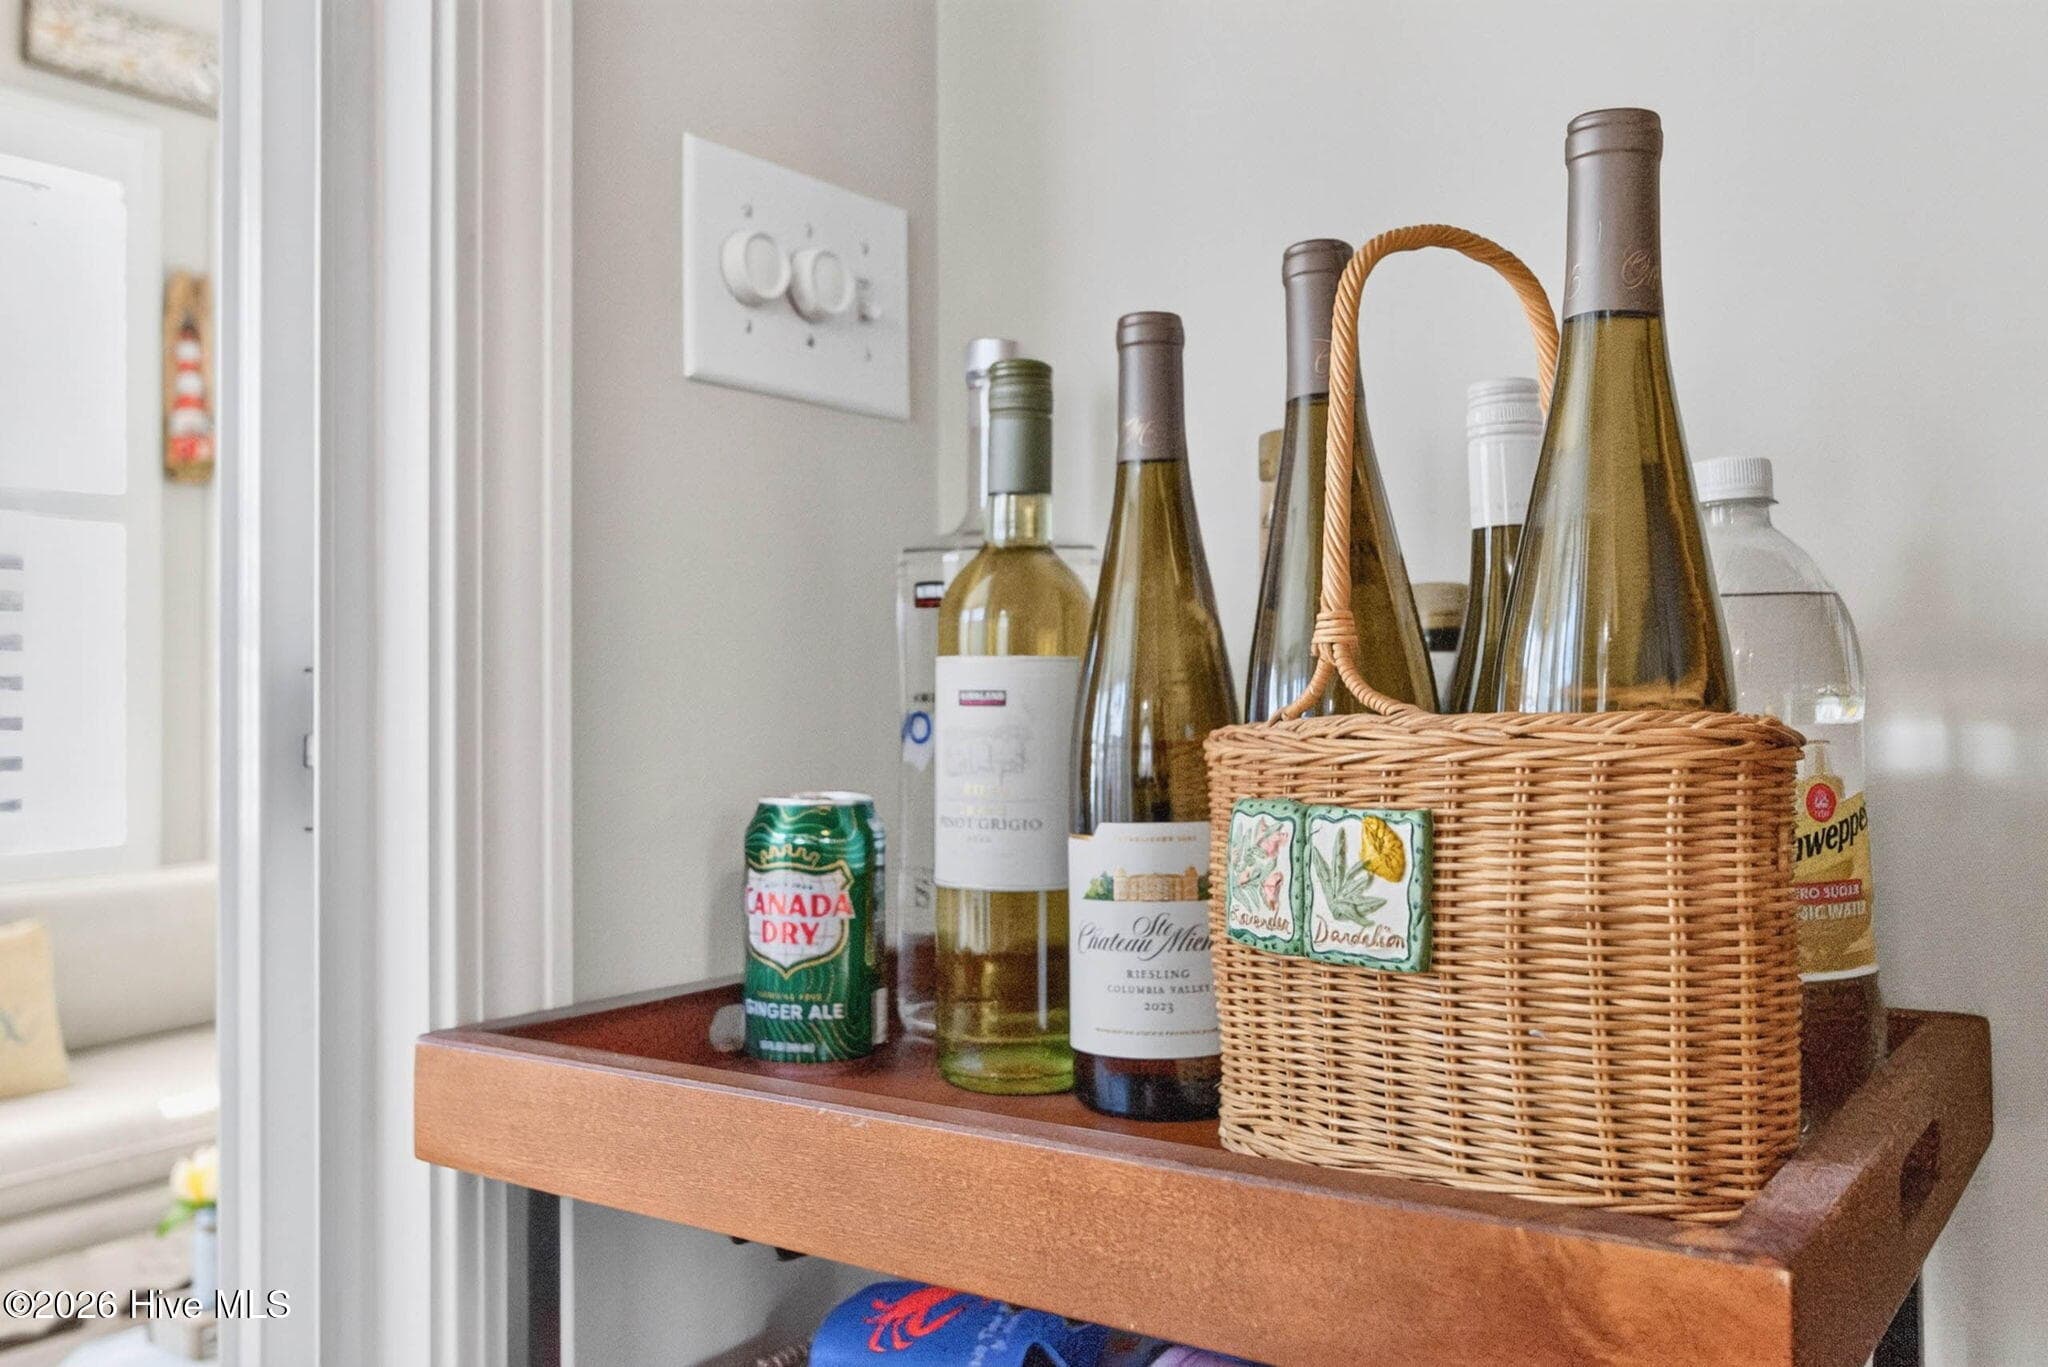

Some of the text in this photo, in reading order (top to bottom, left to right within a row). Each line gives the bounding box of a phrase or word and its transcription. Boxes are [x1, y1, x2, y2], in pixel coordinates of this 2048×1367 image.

[978, 817, 1043, 831] GRIGIO
[745, 887, 855, 918] CANADA
[762, 920, 820, 946] DRY
[1132, 912, 1174, 938] Ste
[1313, 914, 1405, 950] Dandelion
[1078, 922, 1154, 954] Chateau
[1126, 968, 1190, 980] RIESLING
[1106, 983, 1211, 995] COLUMBIA VALLEY
[745, 998, 845, 1020] GINGER ALE
[1143, 1002, 1175, 1015] 2023
